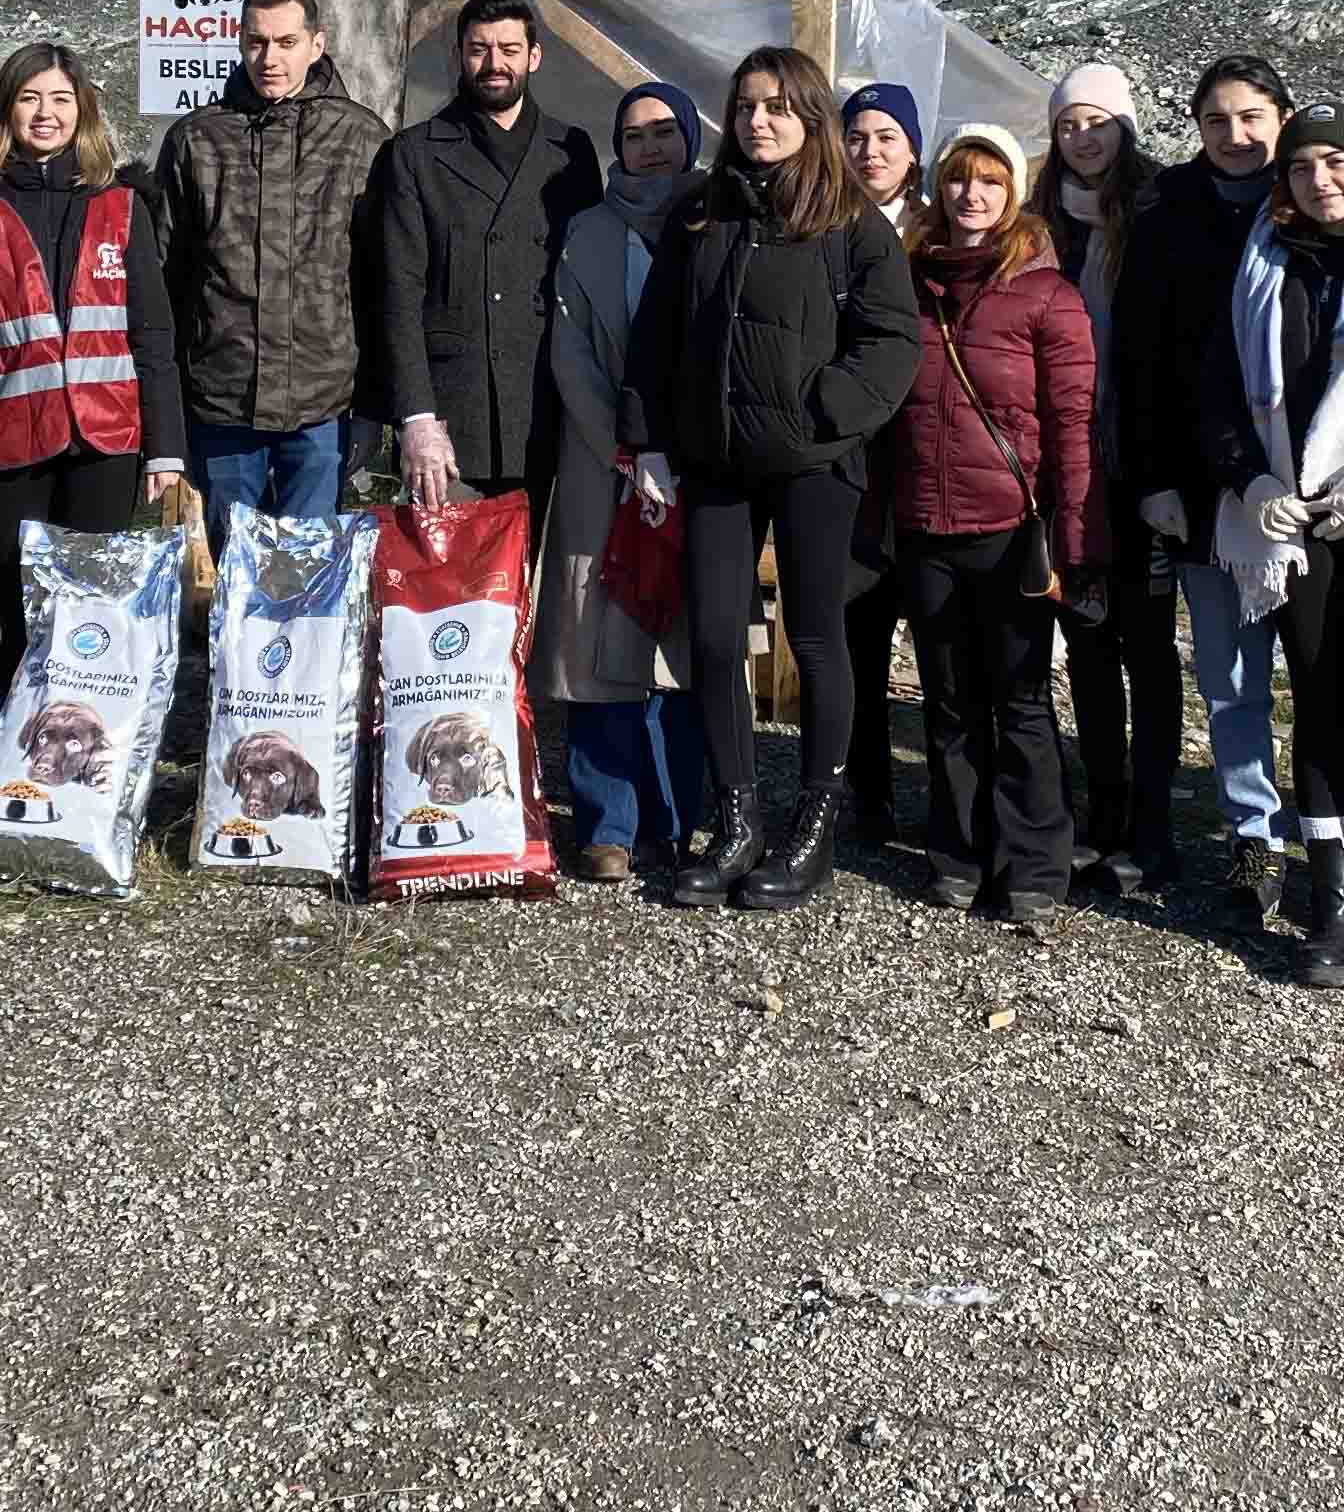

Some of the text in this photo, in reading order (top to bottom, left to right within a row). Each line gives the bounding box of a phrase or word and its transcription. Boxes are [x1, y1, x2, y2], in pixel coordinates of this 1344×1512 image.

[388, 672, 508, 692] CAN DOSTLARIMI
[236, 689, 326, 707] DOSTLARMIZA
[396, 868, 525, 897] TRENDLINE
